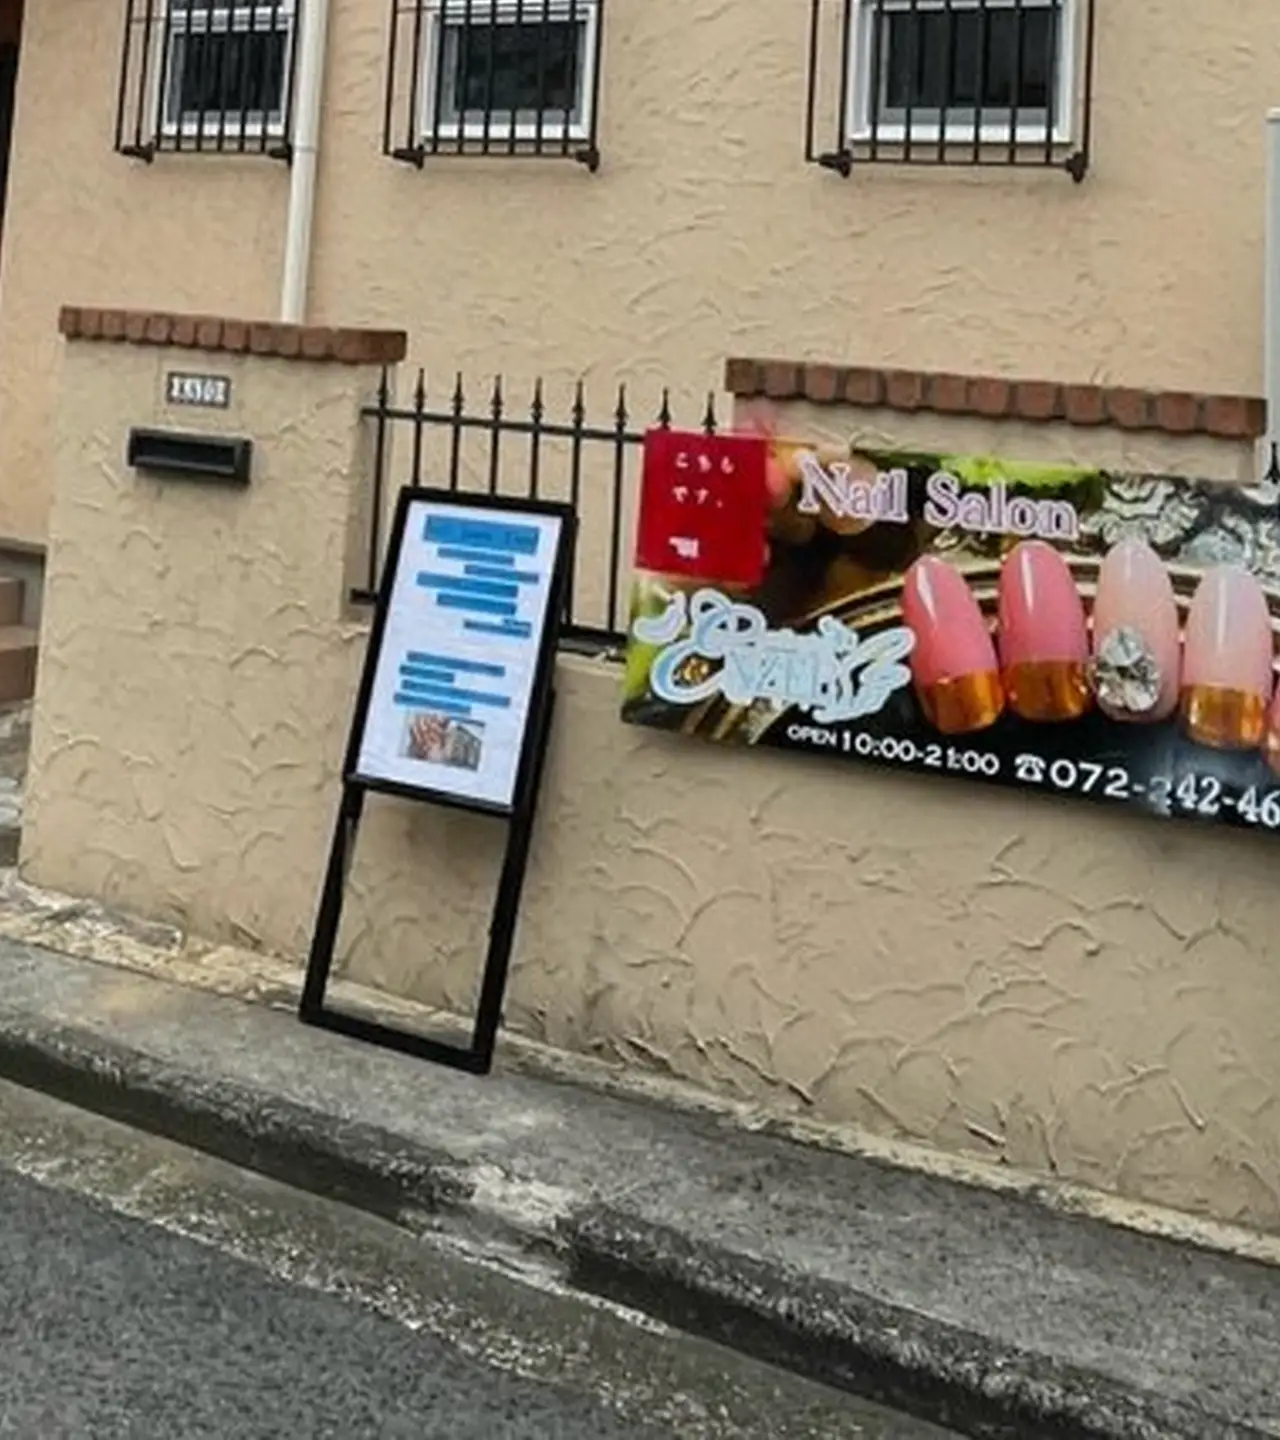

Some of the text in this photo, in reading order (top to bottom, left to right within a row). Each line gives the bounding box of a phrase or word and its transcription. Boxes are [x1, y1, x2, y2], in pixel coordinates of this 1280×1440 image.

[796, 448, 1080, 540] Nail Salon
[786, 724, 1001, 776] OPEN 10:00-21:00
